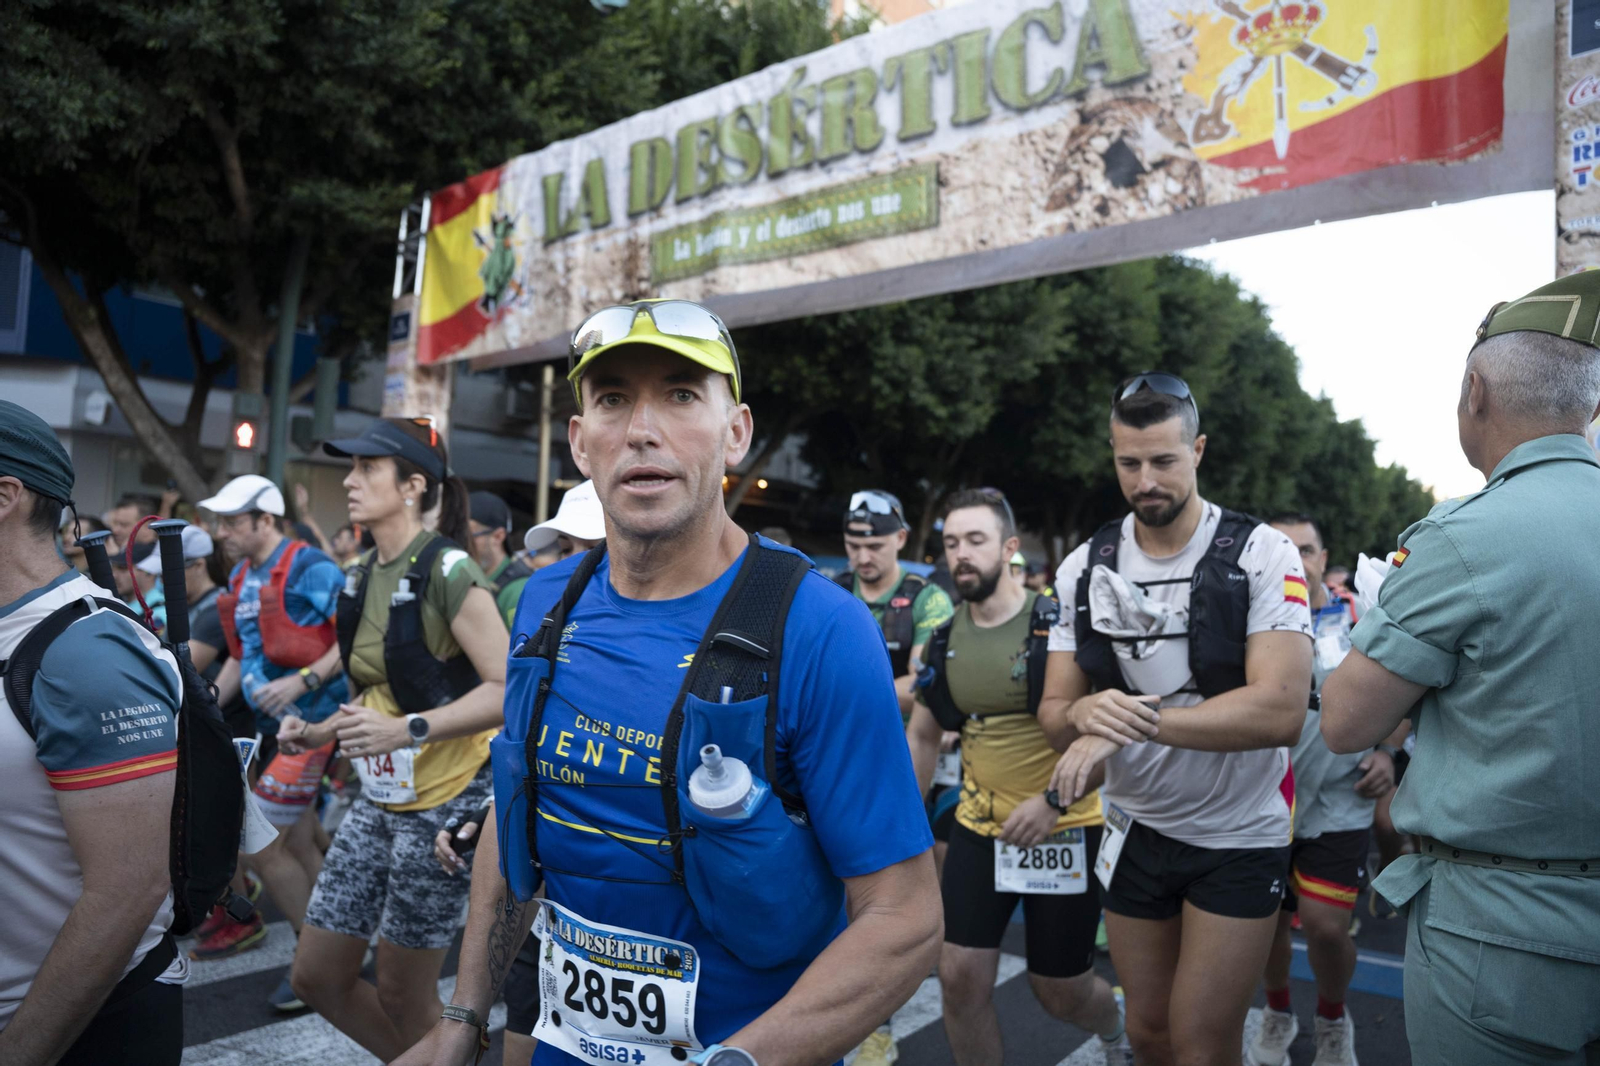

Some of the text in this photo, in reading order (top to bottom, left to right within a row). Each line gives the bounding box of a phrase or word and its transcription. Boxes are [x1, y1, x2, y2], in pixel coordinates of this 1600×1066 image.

[541, 0, 1150, 245] LA DESÉRTICA
[755, 217, 771, 243] el
[837, 200, 866, 224] nos
[871, 192, 902, 217] une
[100, 711, 116, 721] LA
[118, 703, 155, 717] LEGIÓN
[101, 714, 168, 734] EL DESIERTO
[575, 714, 611, 737] CLUB
[117, 728, 164, 744] NOS UNE
[1018, 847, 1072, 870] 2880
[558, 918, 572, 942] LA
[617, 963, 655, 974] ROQUETAS
[655, 967, 666, 975] DE
[666, 968, 683, 978] MAR
[562, 959, 666, 1035] 2859
[579, 1037, 629, 1063] asisa
